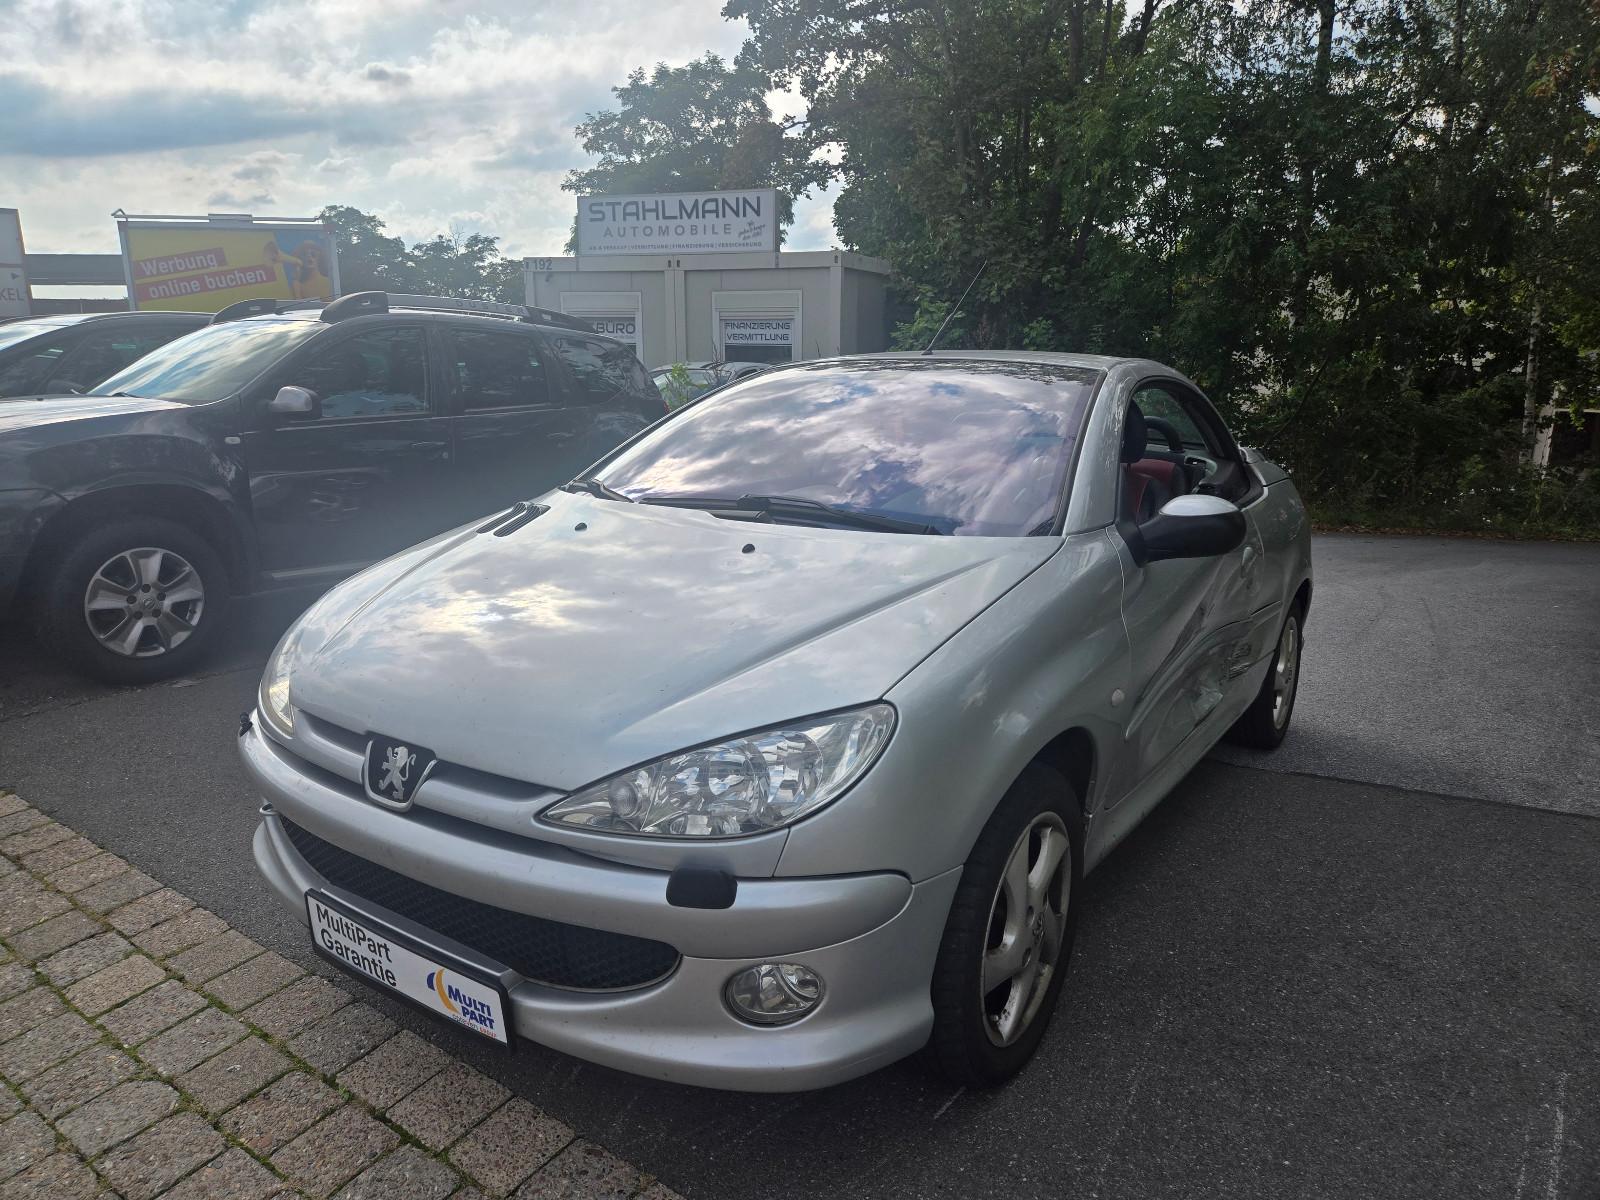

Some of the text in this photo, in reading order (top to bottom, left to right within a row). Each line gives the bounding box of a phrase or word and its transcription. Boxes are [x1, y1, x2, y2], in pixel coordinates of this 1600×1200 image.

[589, 196, 761, 222] STAHLMANN
[603, 223, 732, 238] AUTOMOBILE
[140, 252, 218, 276] Werbung
[534, 259, 552, 270] 192
[149, 266, 267, 299] online buchen
[725, 322, 791, 330] FINANZIERUNG
[727, 333, 789, 341] VERMITTLUNG
[316, 903, 393, 963] MultiPart
[320, 929, 397, 987] Garantie
[447, 985, 492, 1017] MULTI
[461, 1005, 495, 1029] PART
